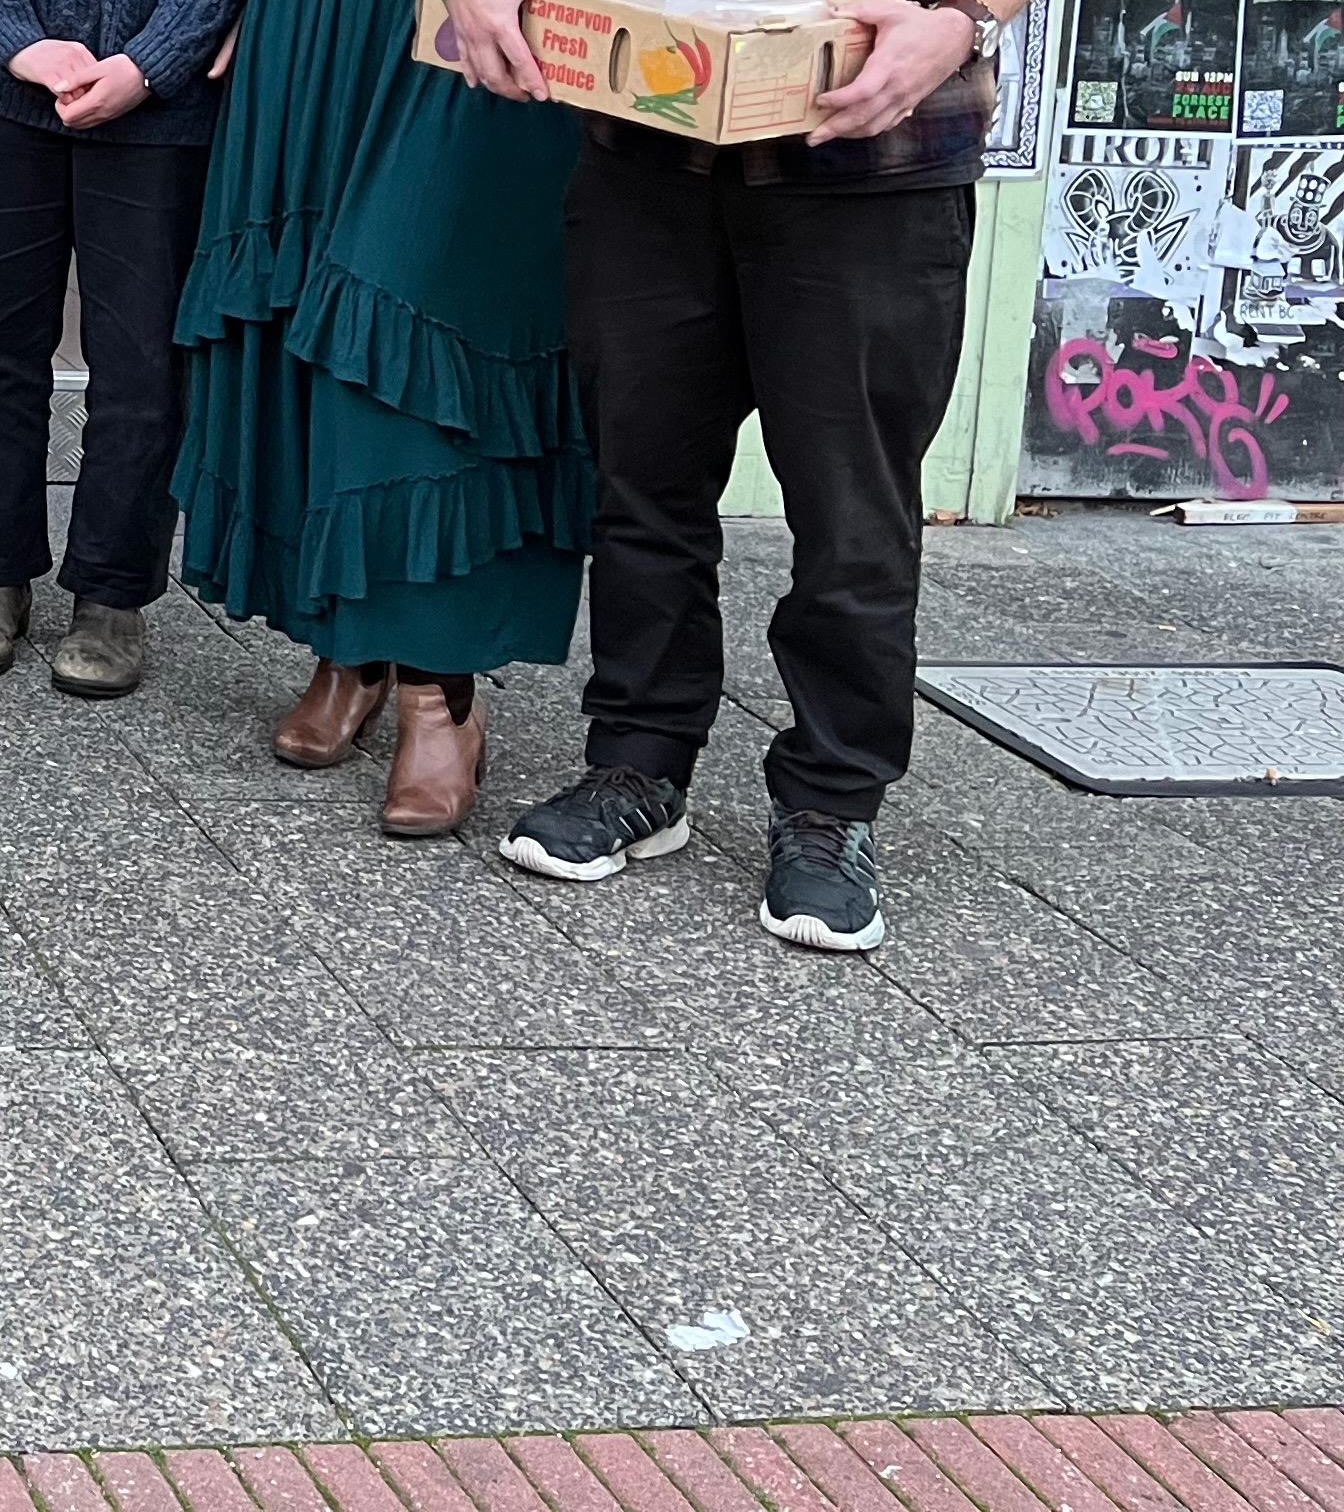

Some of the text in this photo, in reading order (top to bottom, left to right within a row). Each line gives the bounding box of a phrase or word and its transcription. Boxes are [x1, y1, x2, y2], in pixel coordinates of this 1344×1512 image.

[543, 28, 588, 59] Fresh
[538, 59, 595, 91] roduce
[1175, 71, 1233, 83] SUN 12PM
[1174, 94, 1231, 106] FORREST
[1173, 105, 1229, 119] PLACE
